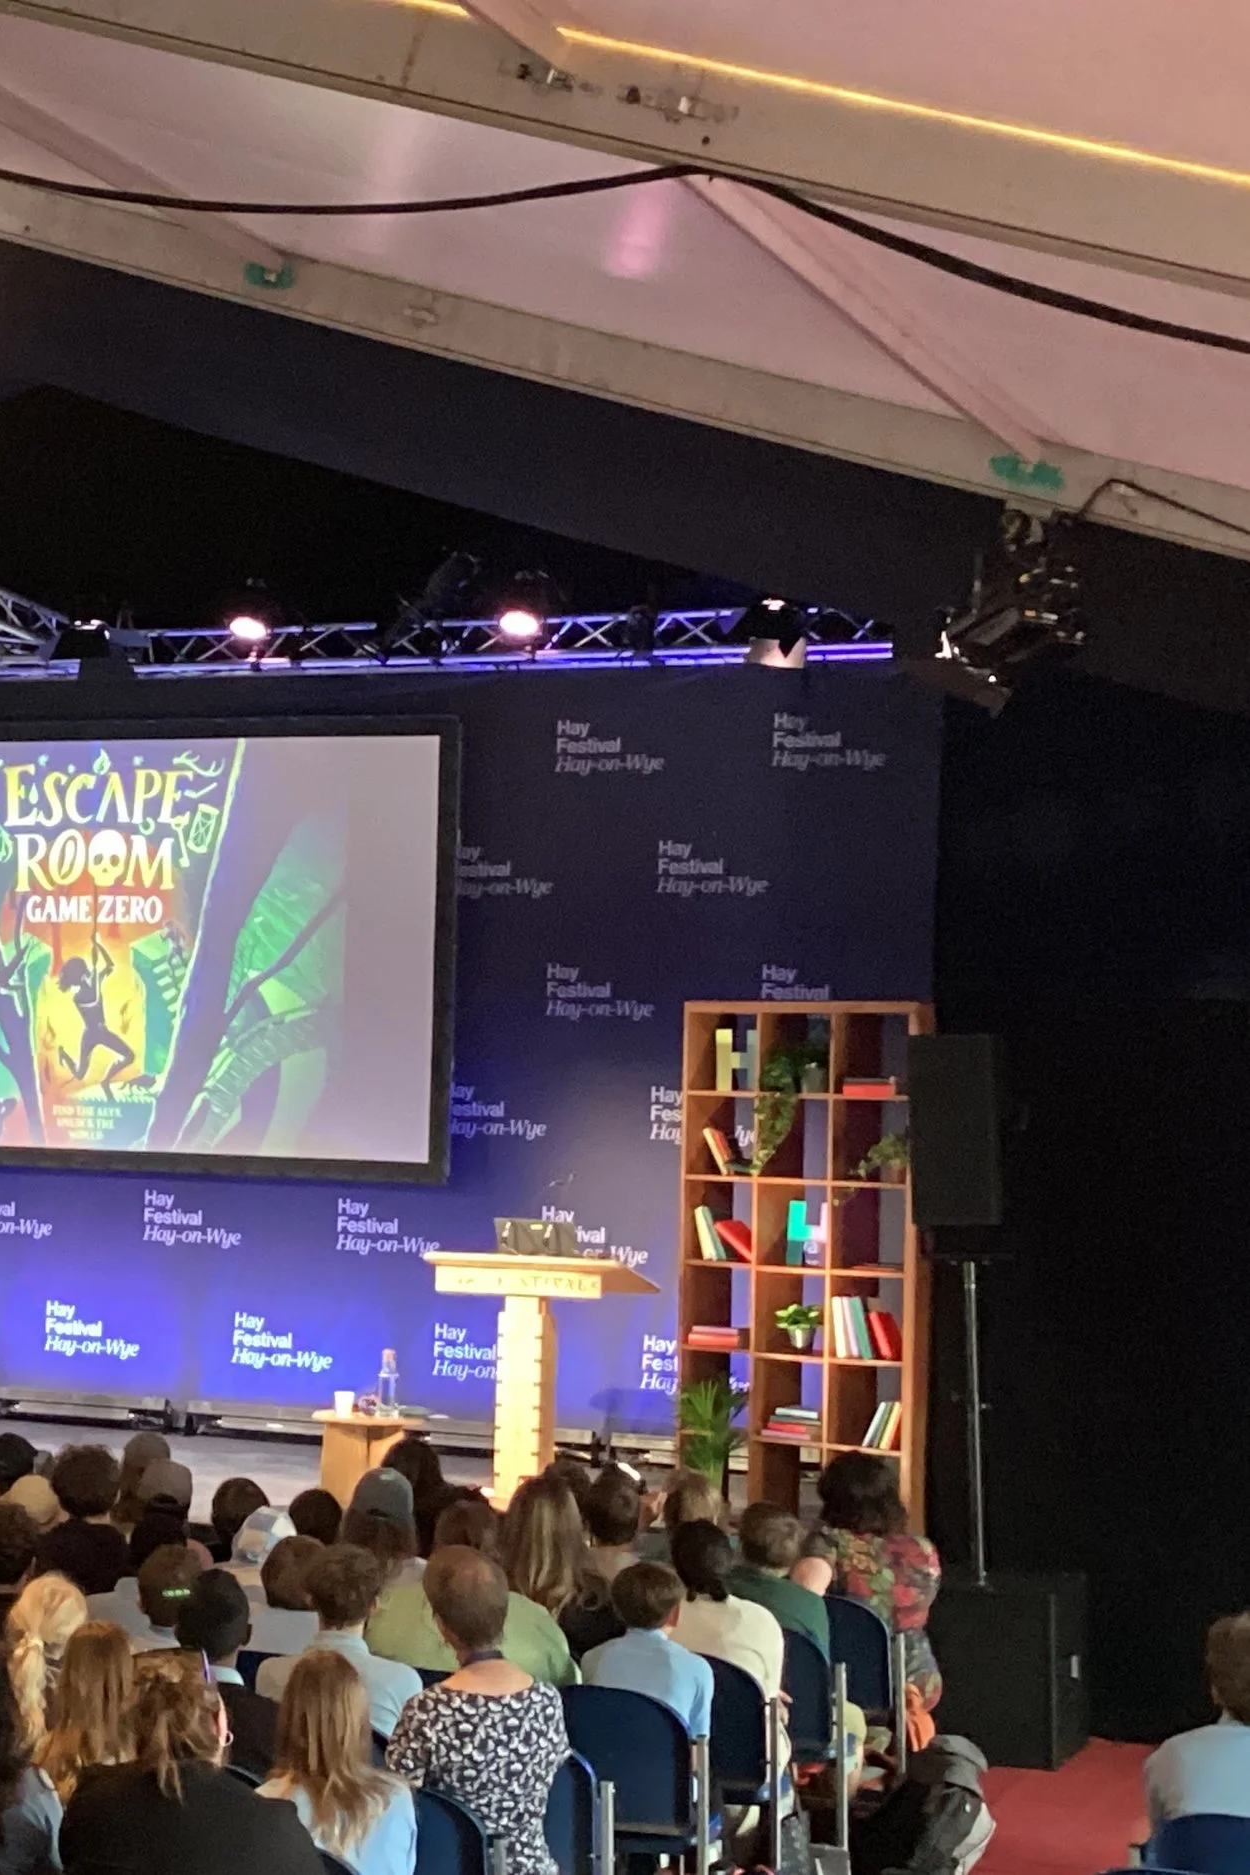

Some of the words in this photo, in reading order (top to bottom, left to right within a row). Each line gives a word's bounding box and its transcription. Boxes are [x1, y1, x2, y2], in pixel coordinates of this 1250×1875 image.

[557, 720, 590, 738] Hay
[557, 737, 621, 754] Festival
[3, 763, 195, 828] ESCAPE
[658, 840, 692, 860] Hay
[456, 860, 511, 878] estival
[658, 858, 724, 876] Festival
[656, 876, 770, 897] Hay-on-Wye
[26, 895, 92, 924] GAME
[97, 894, 163, 924] ZERO
[547, 964, 580, 982] Hay
[761, 964, 798, 984] Hay
[547, 982, 612, 998] Festival
[760, 982, 830, 1000] Festival
[546, 1000, 655, 1023] Hay-on-Wye
[450, 1101, 504, 1118] estival
[144, 1189, 174, 1208] Hay
[338, 1198, 369, 1218] Hay
[144, 1207, 202, 1226] Festival
[337, 1216, 398, 1235] Festival
[143, 1226, 242, 1250] Hay-on-Wye
[336, 1234, 440, 1256] Hay-on-Wye
[46, 1300, 76, 1320] Hay
[45, 1317, 102, 1338] Festival
[234, 1311, 264, 1332] Hay
[233, 1330, 293, 1350] Festival
[434, 1322, 467, 1344] Hay
[44, 1335, 140, 1360] Hay-on-Wye
[433, 1341, 497, 1360] Festival
[644, 1334, 676, 1354] Hay
[232, 1347, 333, 1373] Hay-on-Wye
[432, 1360, 496, 1381] Hay-on
